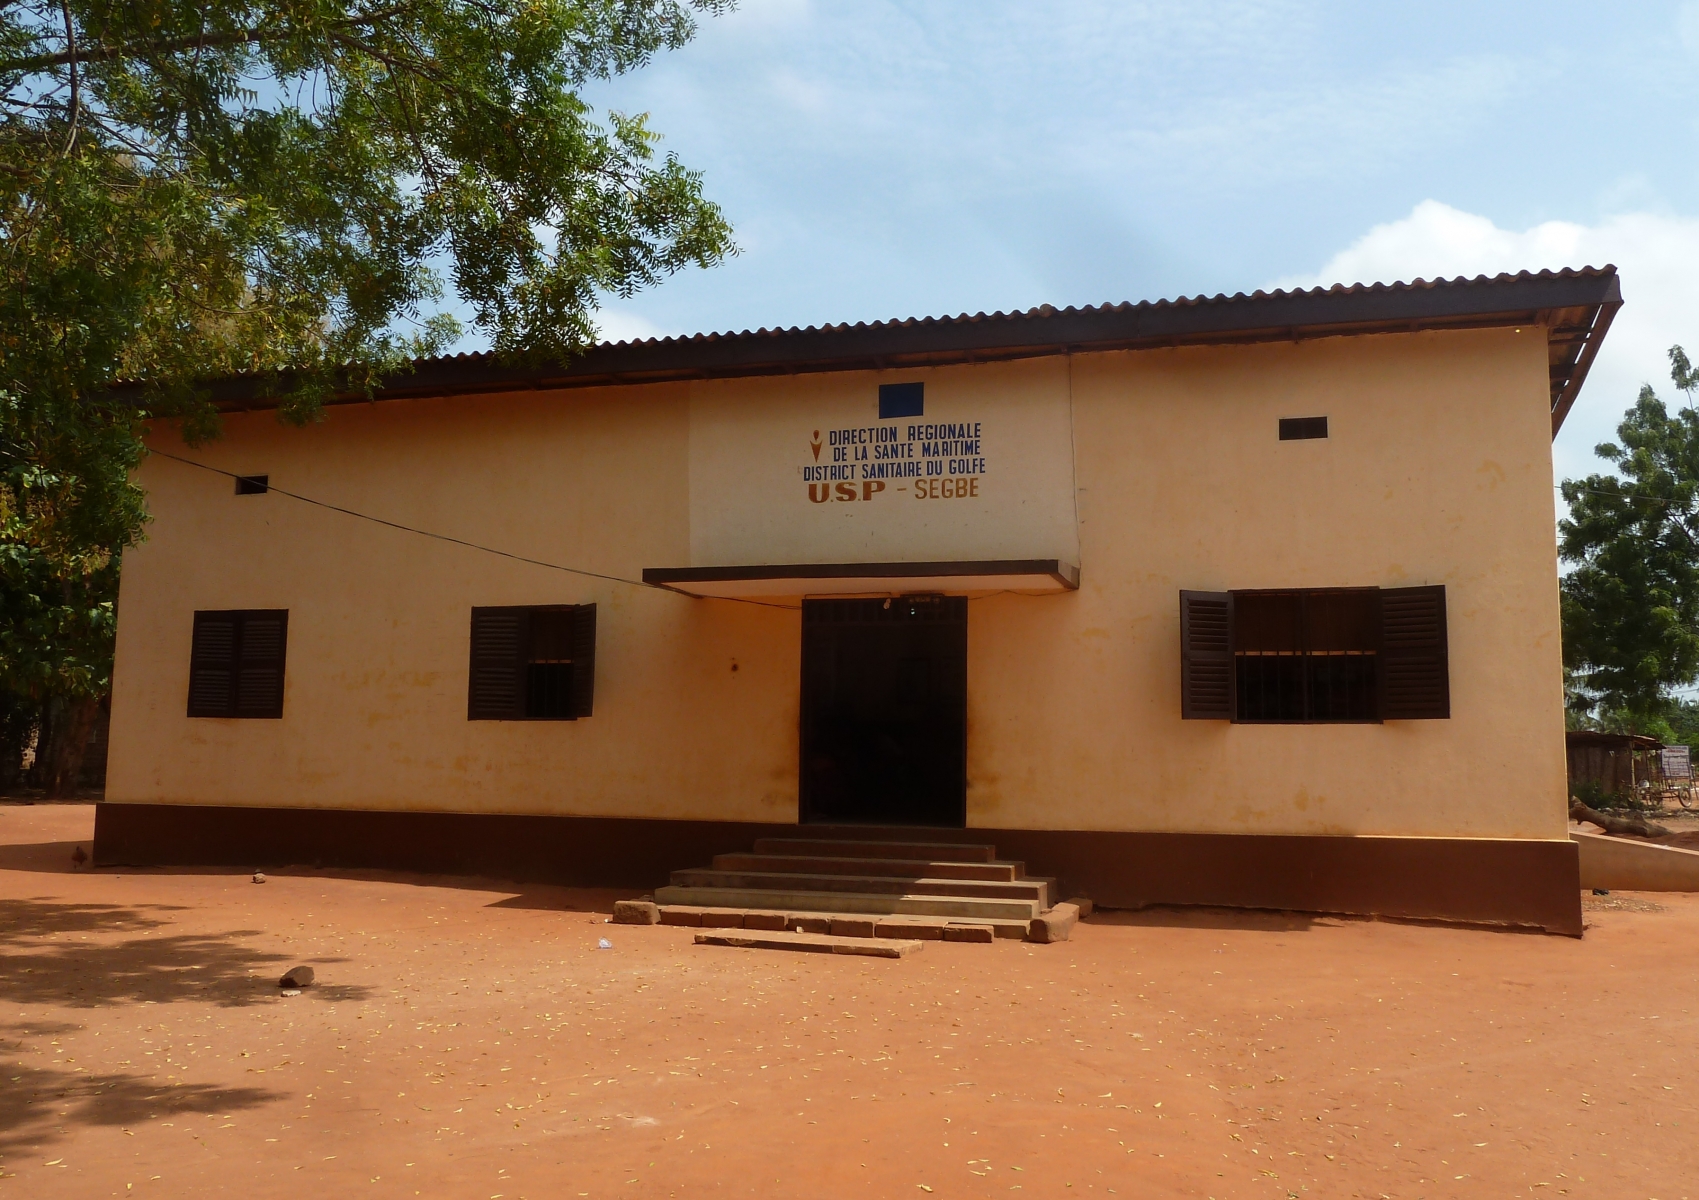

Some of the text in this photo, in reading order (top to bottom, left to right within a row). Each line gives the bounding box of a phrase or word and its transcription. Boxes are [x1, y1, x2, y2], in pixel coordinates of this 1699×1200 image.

[830, 423, 981, 446] DIRECTION REGIONALE
[834, 440, 980, 462] DE LA SANTE MARITIME
[804, 458, 985, 481] DISTRICT SANITAIRE DU GOLFE
[808, 481, 885, 503] U.S.P
[915, 478, 978, 499] SEGBE
